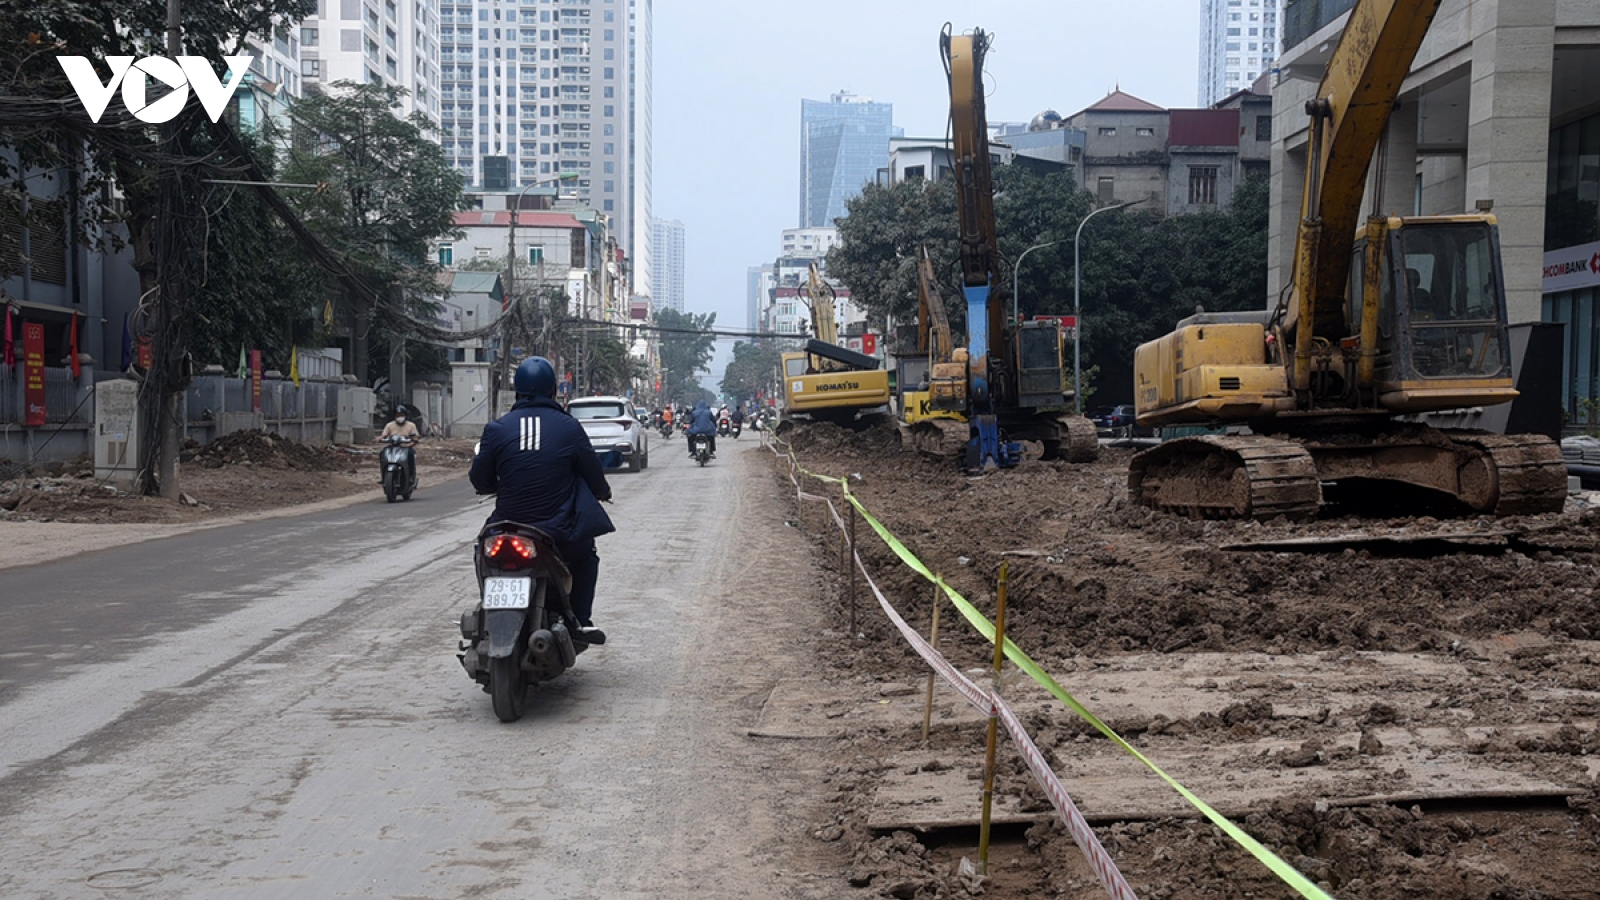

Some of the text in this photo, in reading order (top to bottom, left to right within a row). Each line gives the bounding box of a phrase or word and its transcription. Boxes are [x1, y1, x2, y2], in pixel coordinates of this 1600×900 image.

[816, 381, 859, 391] KOMATSU
[490, 579, 522, 592] 29-G1
[486, 593, 526, 607] 389.75
